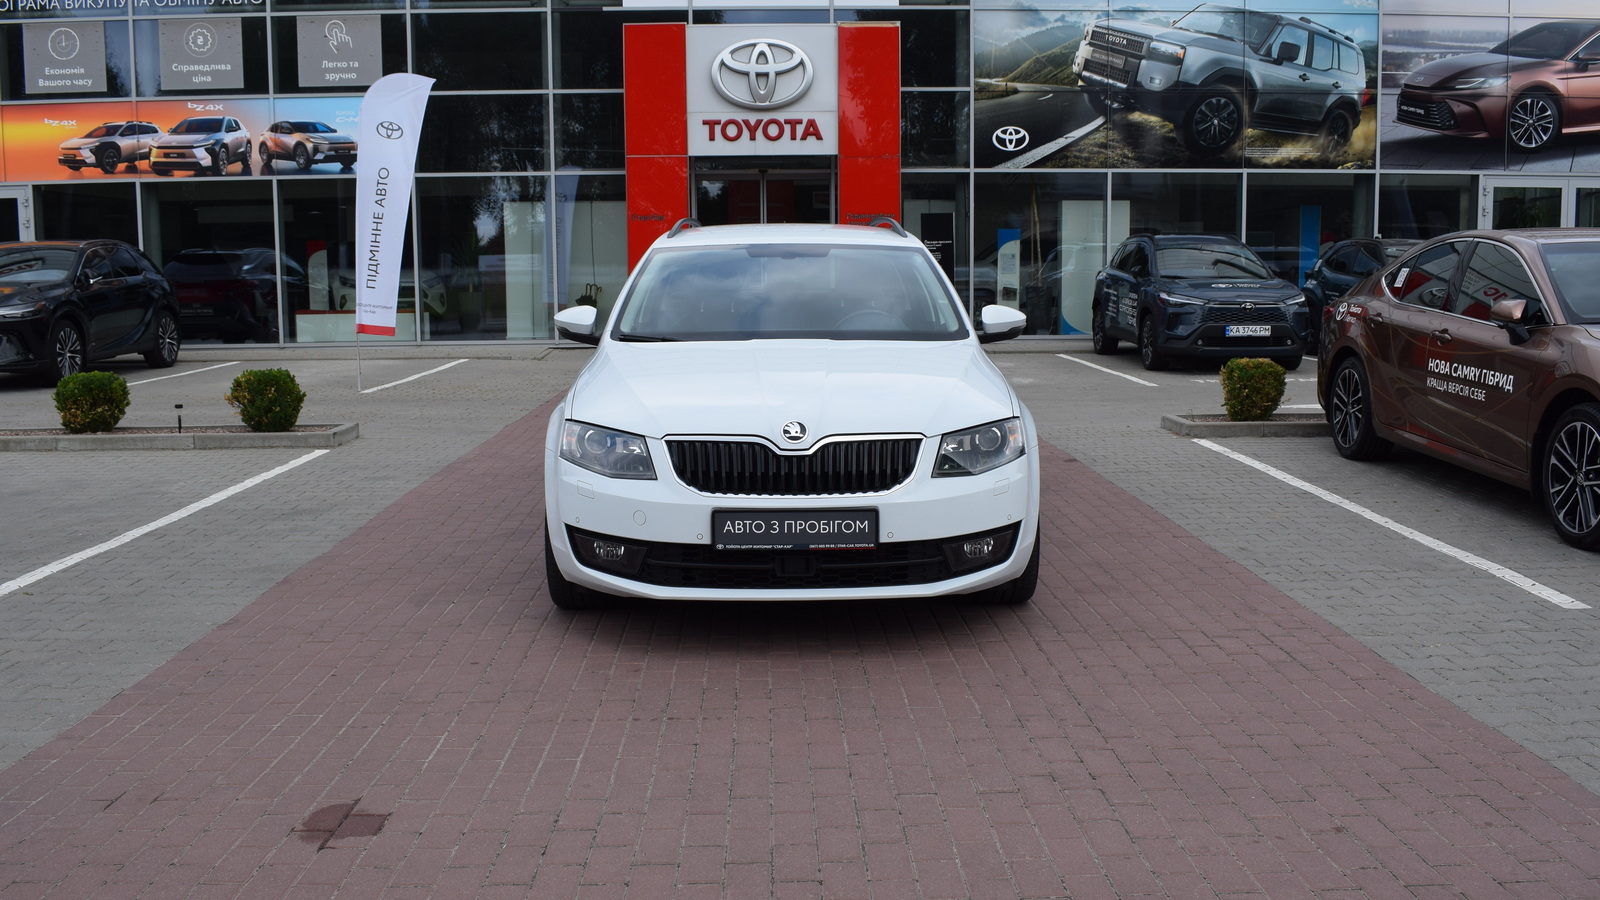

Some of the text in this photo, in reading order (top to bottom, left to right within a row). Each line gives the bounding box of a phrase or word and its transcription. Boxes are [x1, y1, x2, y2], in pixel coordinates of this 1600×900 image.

[1105, 34, 1127, 45] TOYOTA
[172, 63, 232, 73] Справедлива
[321, 60, 348, 68] Легко
[44, 66, 85, 75] Економія
[192, 74, 212, 83] ціна
[325, 72, 357, 81] зручно
[38, 78, 93, 87] Вашого часу
[702, 118, 823, 142] TOYOTA
[366, 167, 390, 290] ПІДМІННЕ АВТО
[1428, 358, 1514, 393] НОВА CAMRY ГІБРИД
[1426, 377, 1486, 402] КРАЩА ВЕРСІЯ СЕБЕ
[723, 520, 766, 533] АВТО
[784, 520, 869, 533] ПРОБІГОМ
